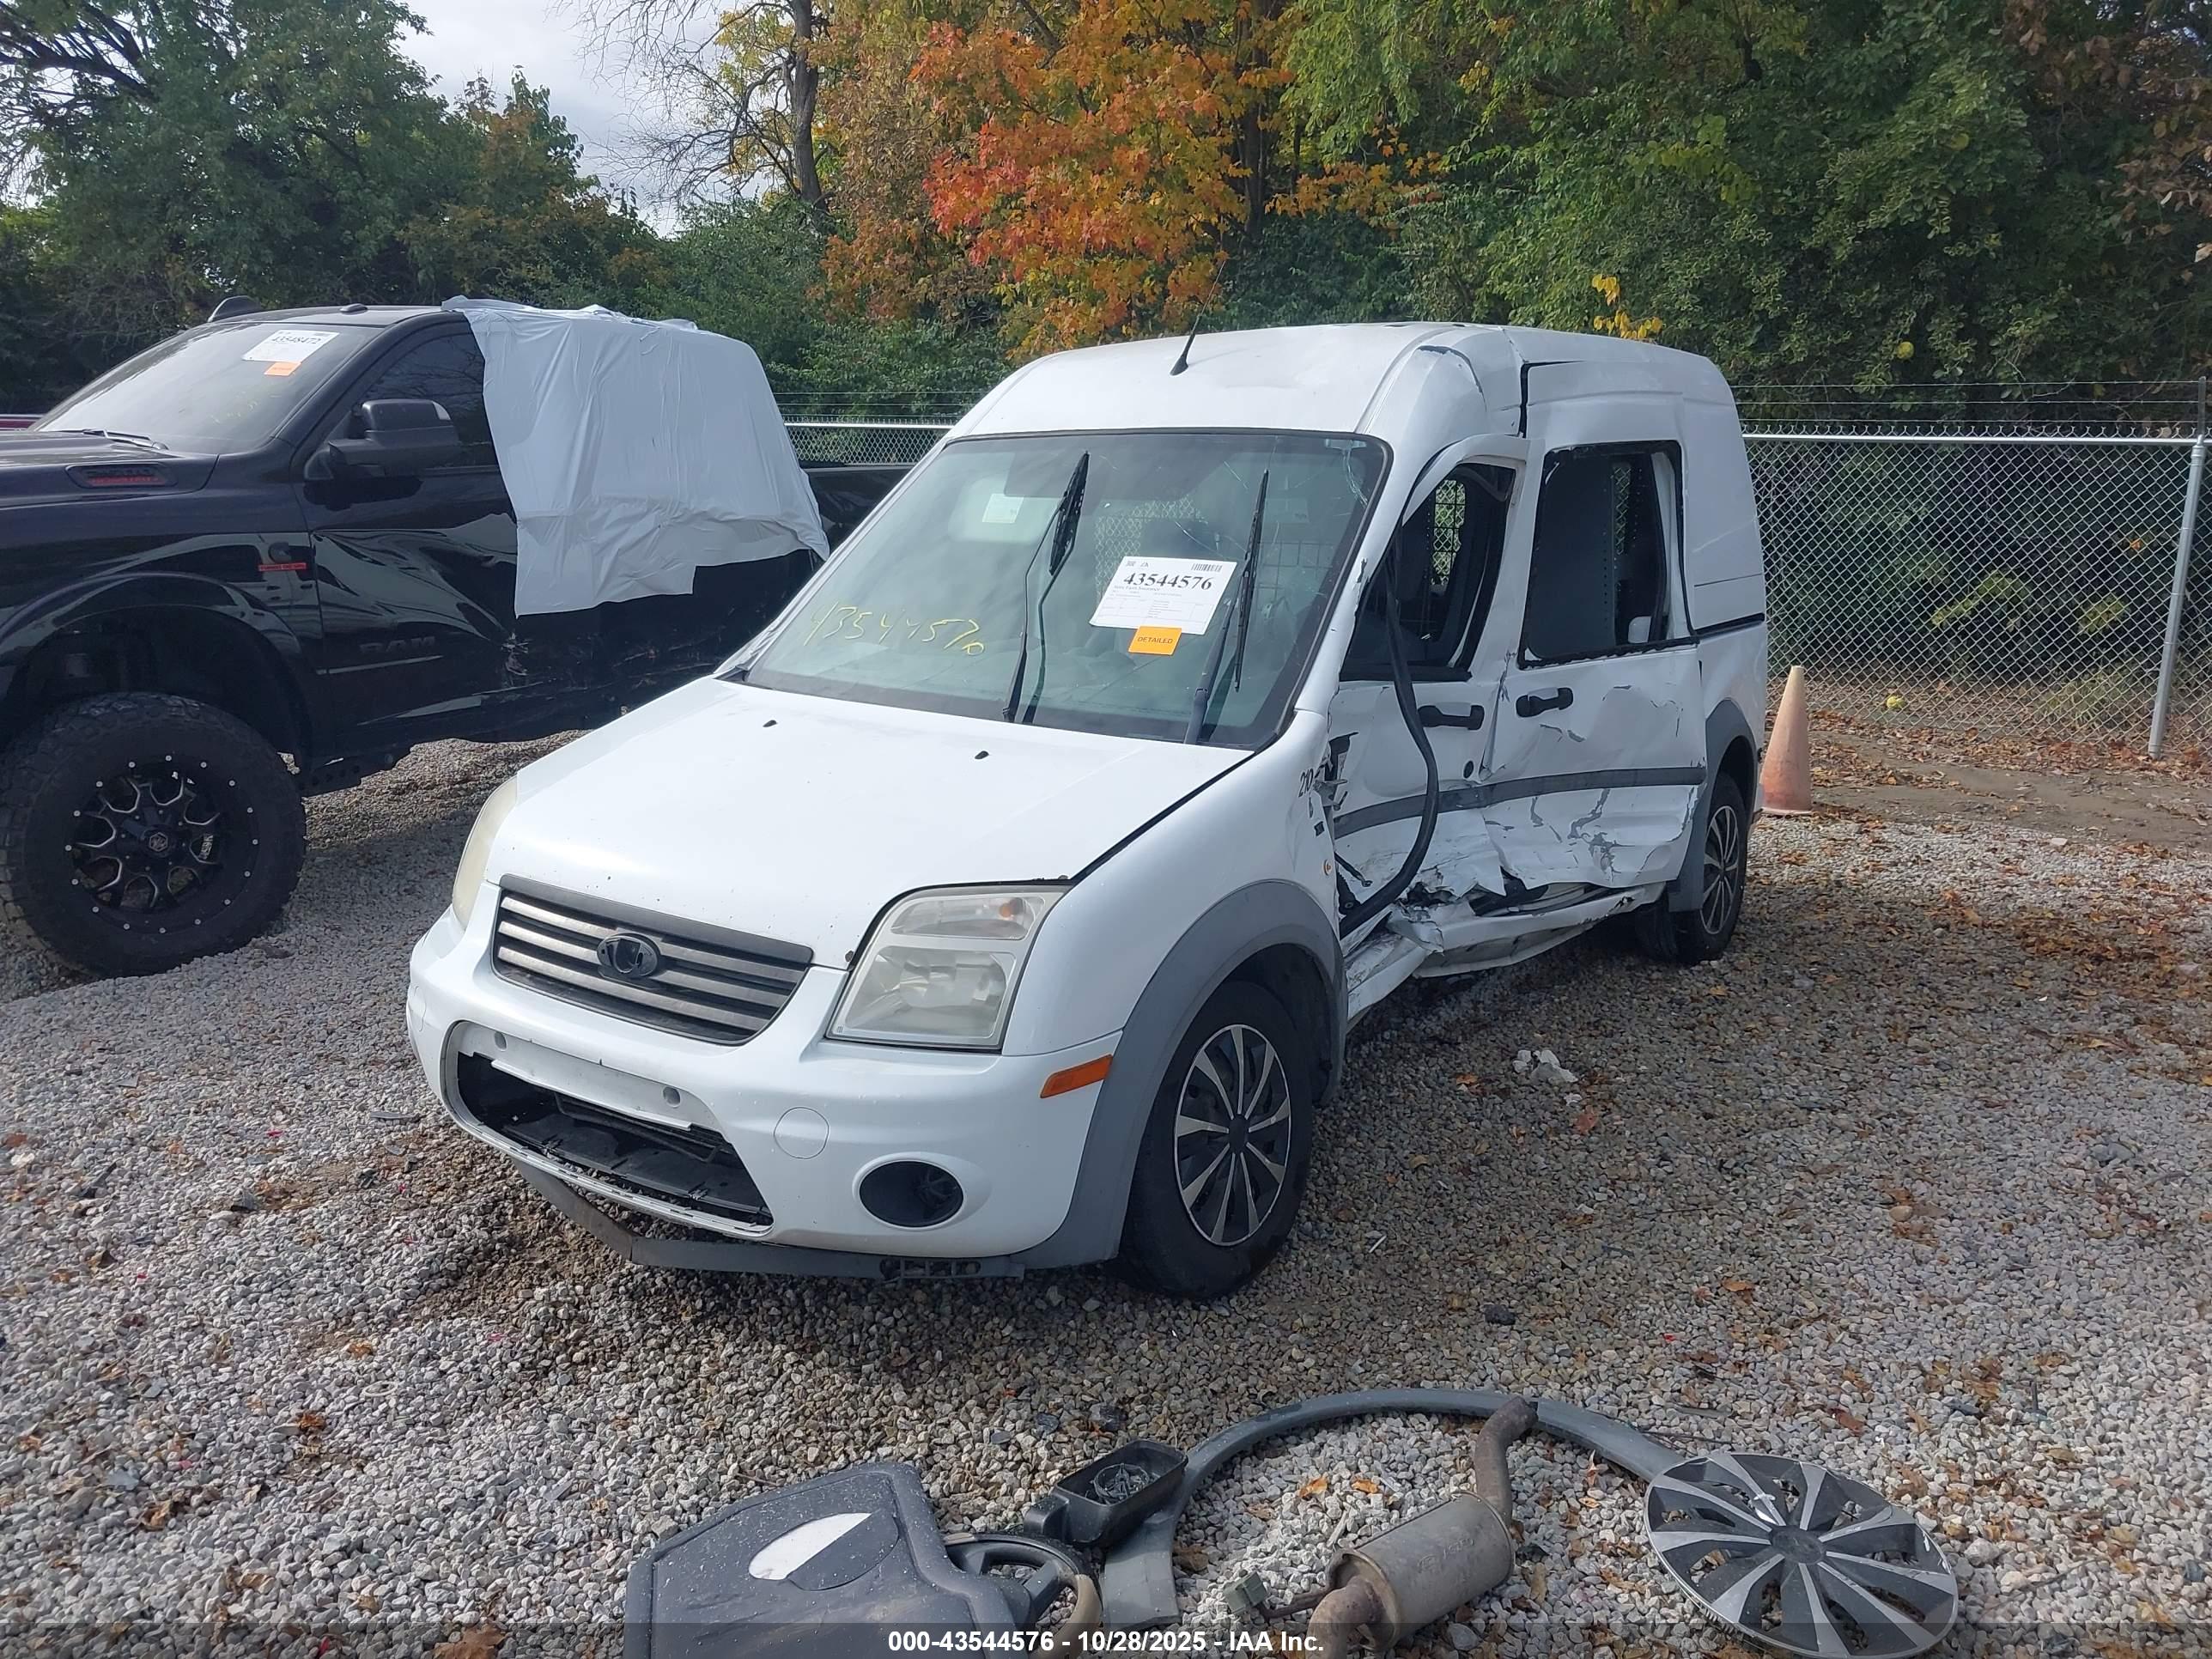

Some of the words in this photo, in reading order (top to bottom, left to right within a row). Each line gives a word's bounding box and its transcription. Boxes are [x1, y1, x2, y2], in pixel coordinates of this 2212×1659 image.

[1123, 572, 1214, 591] 43544576
[359, 635, 435, 653] RAM
[1137, 635, 1174, 644] DETAILED
